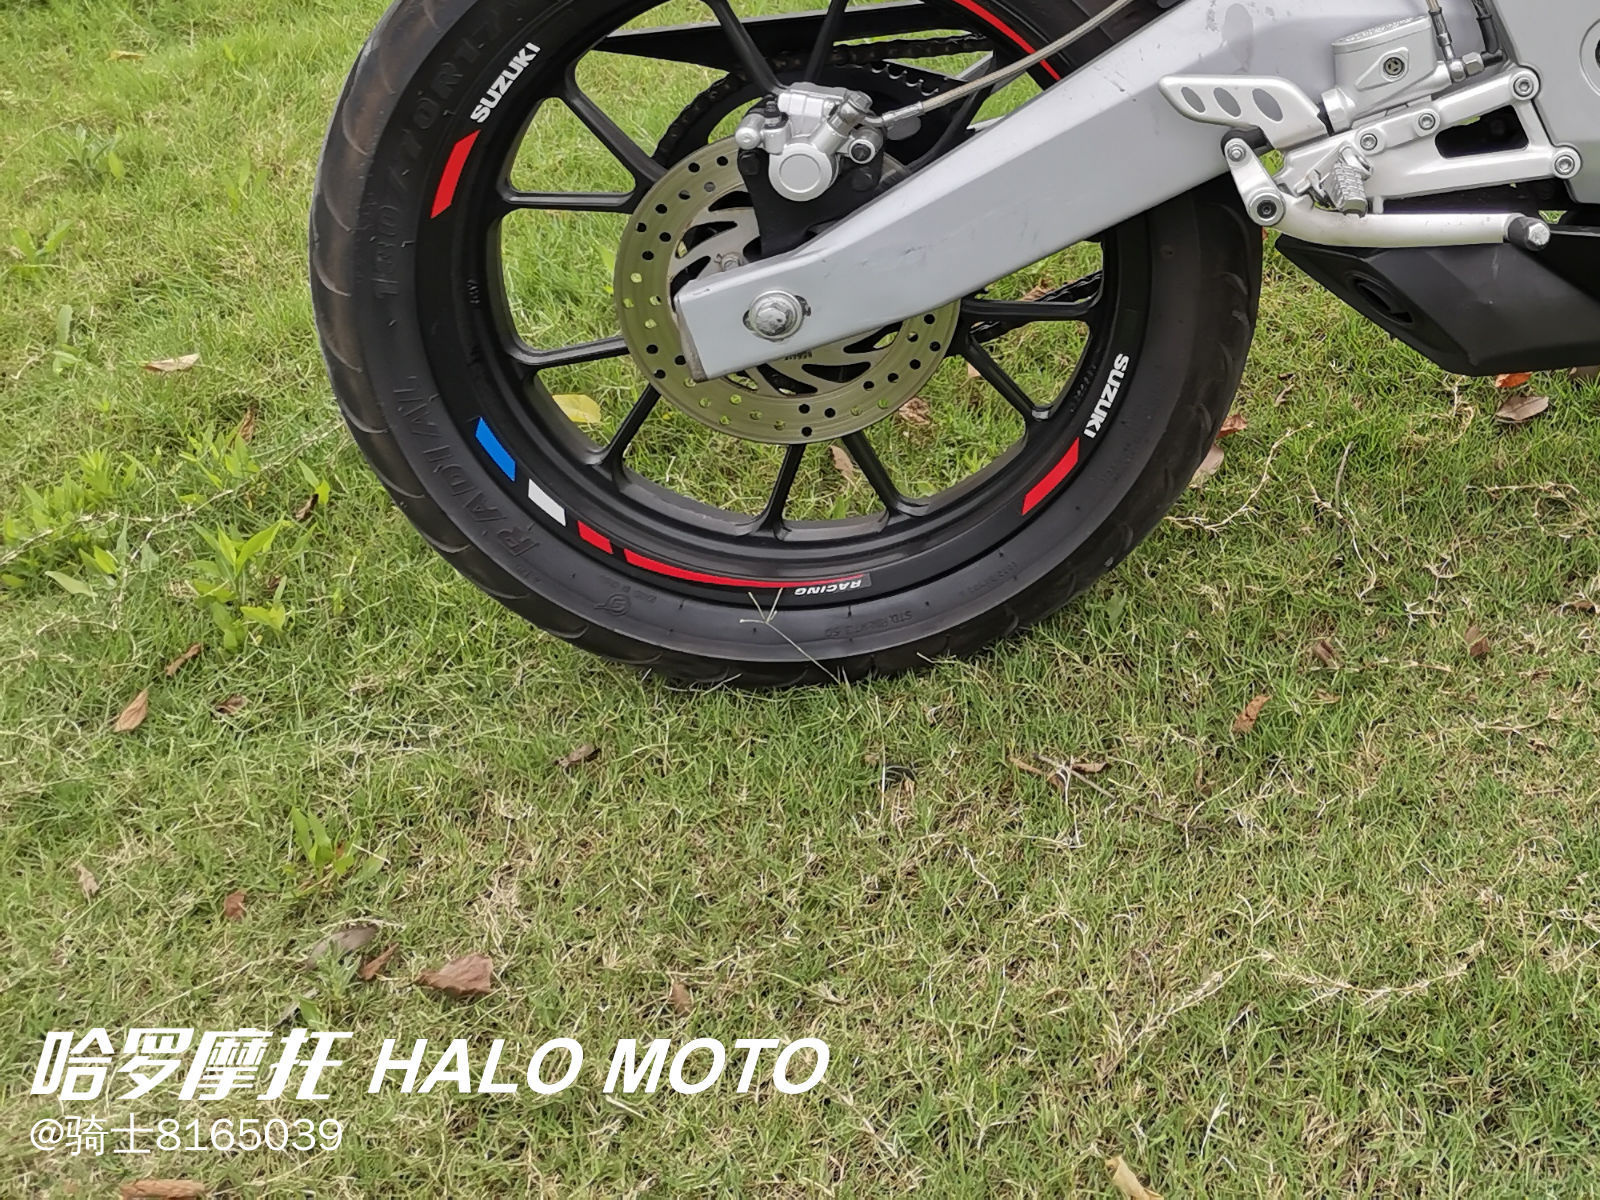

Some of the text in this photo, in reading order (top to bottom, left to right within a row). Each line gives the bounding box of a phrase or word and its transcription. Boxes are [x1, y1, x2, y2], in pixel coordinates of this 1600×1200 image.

[470, 42, 541, 123] SUZUKI
[1083, 353, 1130, 438] SUZUKI
[793, 579, 862, 596] RACING
